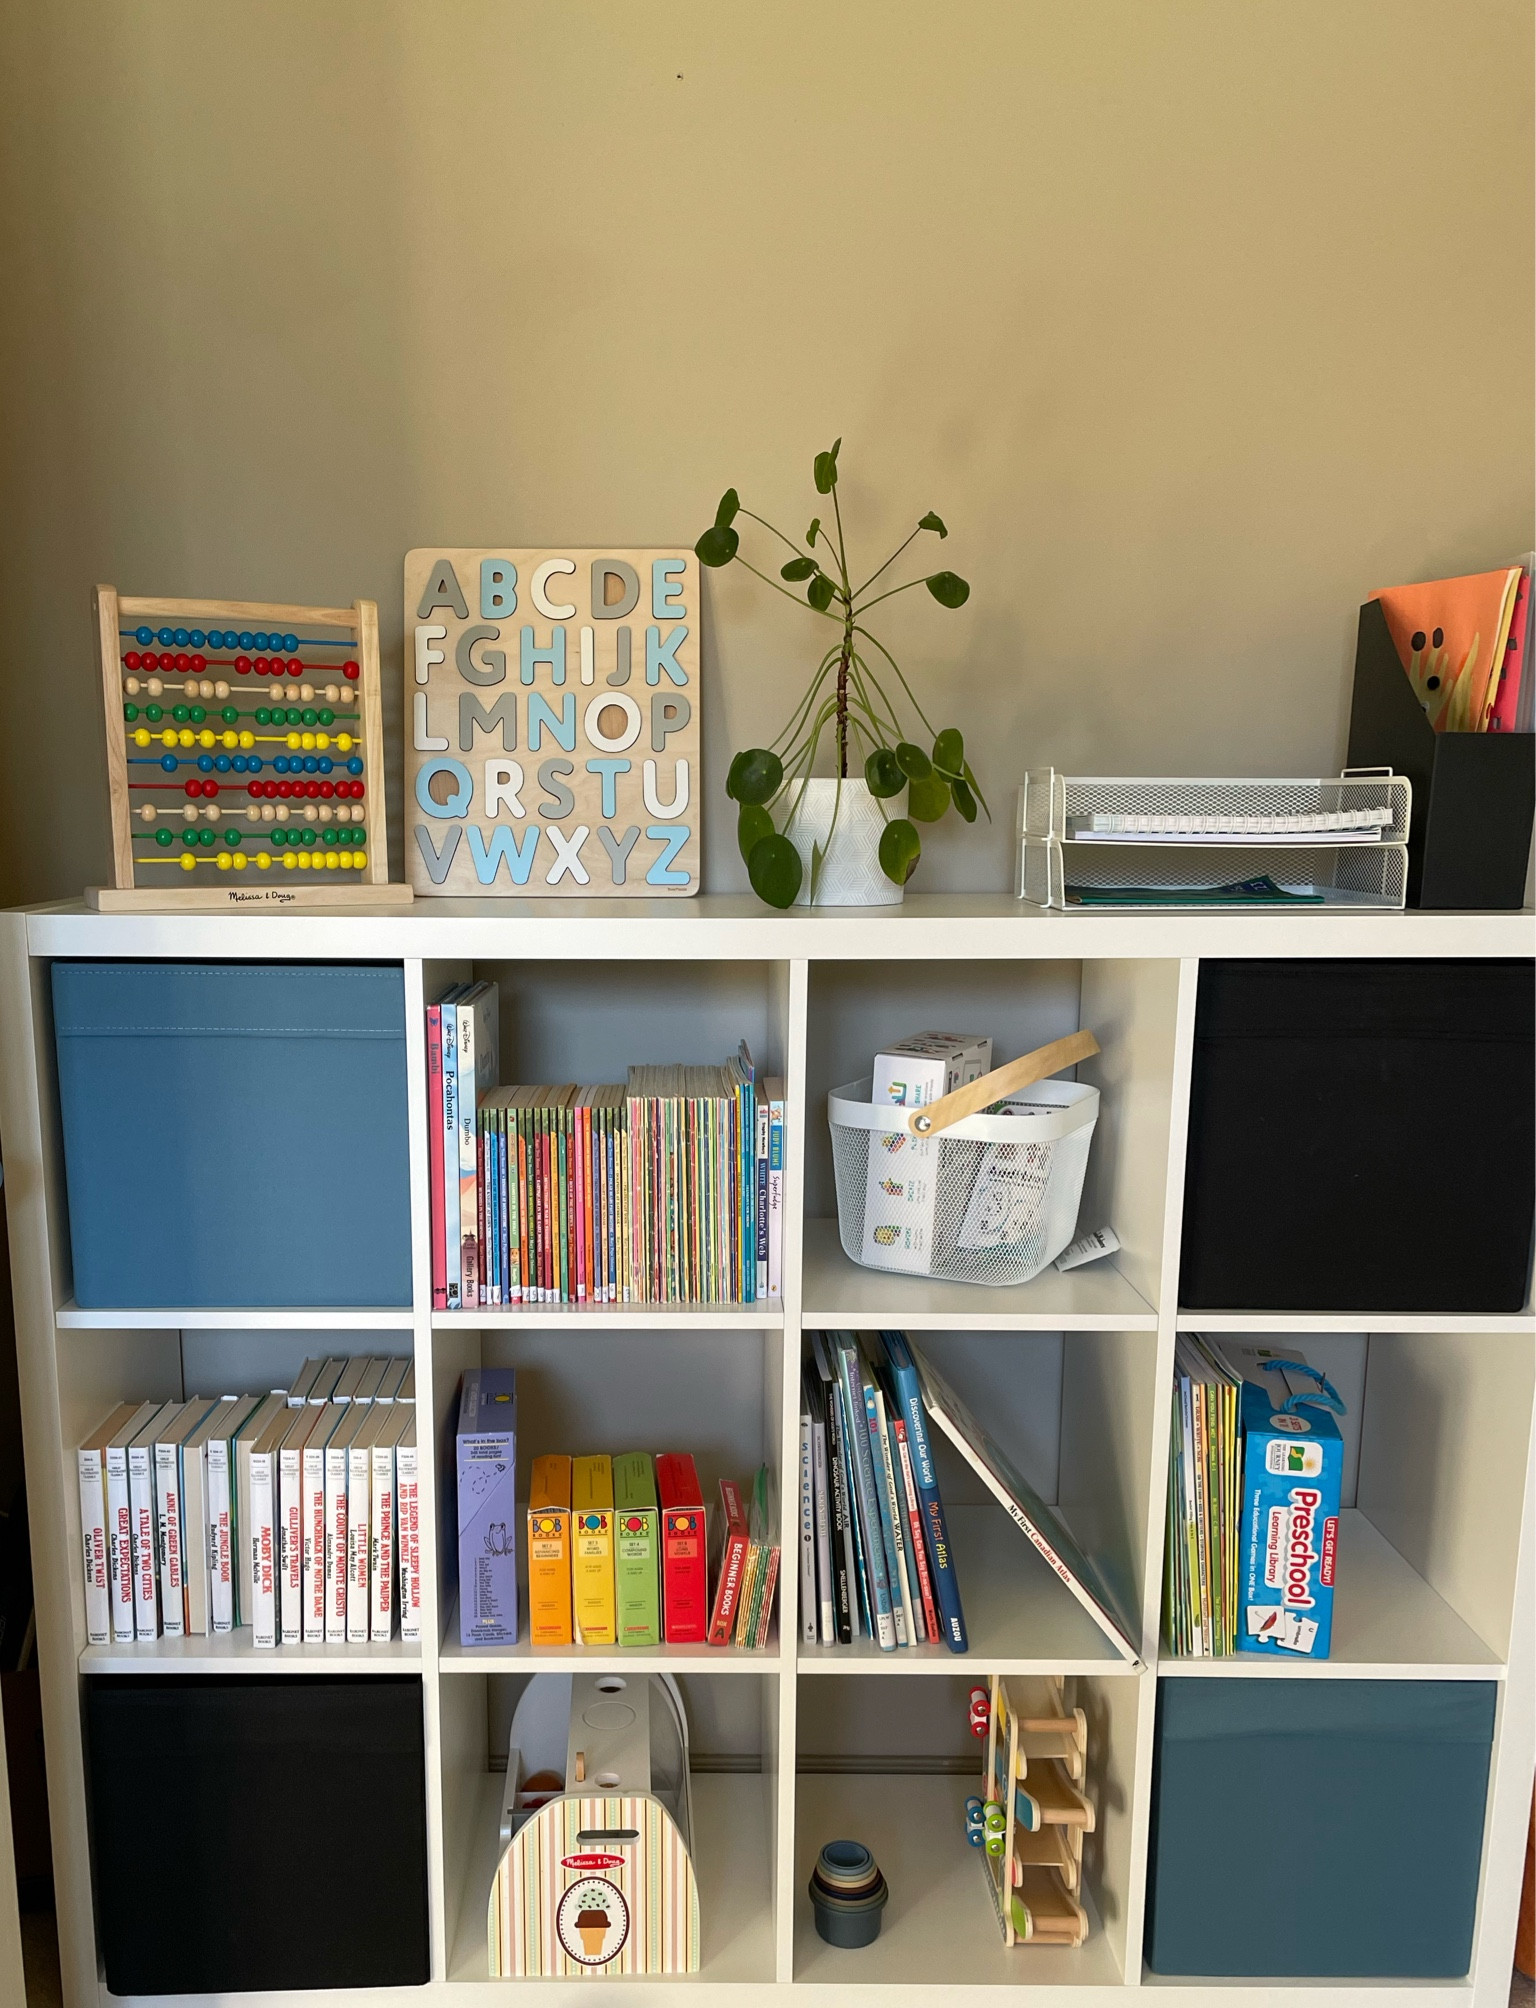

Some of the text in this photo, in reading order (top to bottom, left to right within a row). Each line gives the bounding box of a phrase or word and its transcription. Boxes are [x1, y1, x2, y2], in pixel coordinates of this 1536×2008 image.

[229, 891, 263, 902] Melissa
[272, 891, 291, 903] Doug
[431, 1043, 440, 1074] Bambi
[446, 1071, 455, 1130] Pocahontas
[772, 1130, 780, 1166] JUDY BLUME
[769, 1176, 781, 1210] Superfudge
[759, 1190, 767, 1235] Charlotte's
[759, 1238, 767, 1256] Web
[465, 1256, 475, 1297] Gallery Books
[869, 1417, 877, 1435] 101
[909, 1398, 933, 1483] Discovering Our World
[400, 1483, 408, 1499] AND
[832, 1457, 840, 1487] DINOSAUR
[400, 1502, 408, 1515] RIP
[859, 1428, 883, 1570] 100 Science Experiments
[887, 1473, 892, 1481] of
[894, 1523, 903, 1552] WATER
[140, 1516, 150, 1537] TALE
[166, 1493, 179, 1588] ANNE OF GREEN GABLES
[401, 1517, 409, 1532] VAN
[533, 1518, 562, 1534] BOB
[579, 1515, 608, 1530] BOB
[620, 1517, 649, 1532] BOB
[668, 1516, 697, 1531] BOB
[929, 1502, 948, 1569] My First Atlas
[1252, 1508, 1260, 1543] Educational
[94, 1528, 105, 1589] OLIVER TWIST
[119, 1508, 131, 1603] GREAT EXPECTATIONS
[141, 1539, 150, 1550] OF
[142, 1553, 151, 1572] TWO
[210, 1524, 219, 1570] Rudyard Kipling
[219, 1512, 230, 1583] THE JUNGLE BOOK
[261, 1526, 272, 1594] MOBY DICK
[290, 1507, 299, 1588] GULLIVER'S TRAVELS
[314, 1491, 323, 1618] THE HUNCHBACK OF NOTRE DAME
[336, 1493, 345, 1617] THE COUNT OF MONTE CRISTO
[349, 1551, 357, 1562] May
[358, 1524, 367, 1588] LITTLE WOMEN
[380, 1492, 391, 1612] THE PRINCE AND THE PAUPER
[401, 1534, 409, 1563] WINKLE
[409, 1483, 420, 1607] THE LEGEND OF SLEEPY HOLLOW
[1007, 1504, 1071, 1583] My First Canadian Atlas
[1250, 1543, 1258, 1565] Games
[1266, 1511, 1282, 1583] Learning Library
[1288, 1491, 1318, 1605] Preschool
[1323, 1520, 1335, 1583] LET'S GET READY!
[142, 1574, 153, 1601] CITIES
[721, 1543, 743, 1616] BEGINNER BOOKS
[840, 1570, 848, 1613] SNELLENBERGER
[715, 1628, 725, 1639] A
[950, 1618, 962, 1642] AUZOU
[566, 1858, 596, 1868] Melissa
[603, 1858, 620, 1868] Doug
